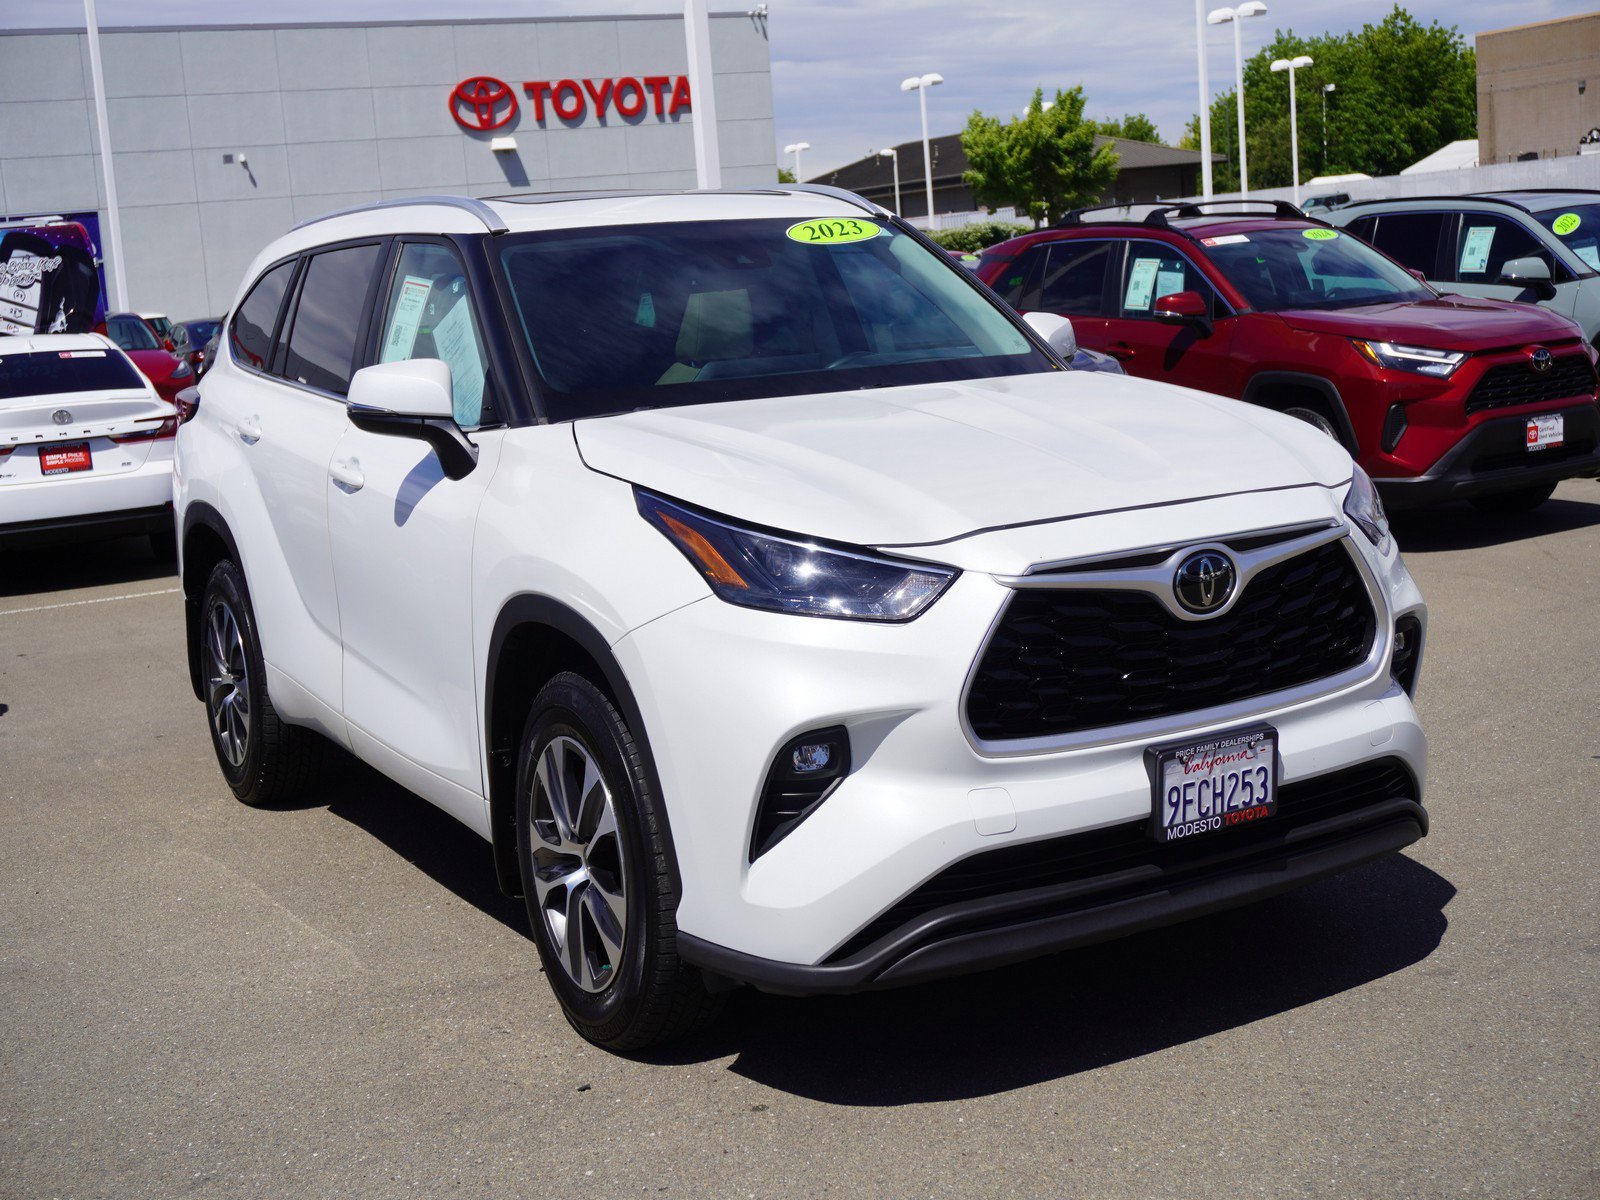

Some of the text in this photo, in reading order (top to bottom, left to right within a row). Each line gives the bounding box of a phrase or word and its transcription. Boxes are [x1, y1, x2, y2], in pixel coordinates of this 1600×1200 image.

[523, 75, 692, 121] TOYOTA
[802, 220, 863, 241] 2023
[1557, 216, 1576, 232] 2022
[45, 453, 67, 461] SIMPLE
[45, 467, 69, 475] MODESTO
[1175, 732, 1264, 759] PRICE FAMILY DEALERSHIPS
[1183, 748, 1255, 776] California
[1167, 765, 1268, 826] 9FCH253
[1167, 805, 1269, 841] MODESTO TOYOTA
